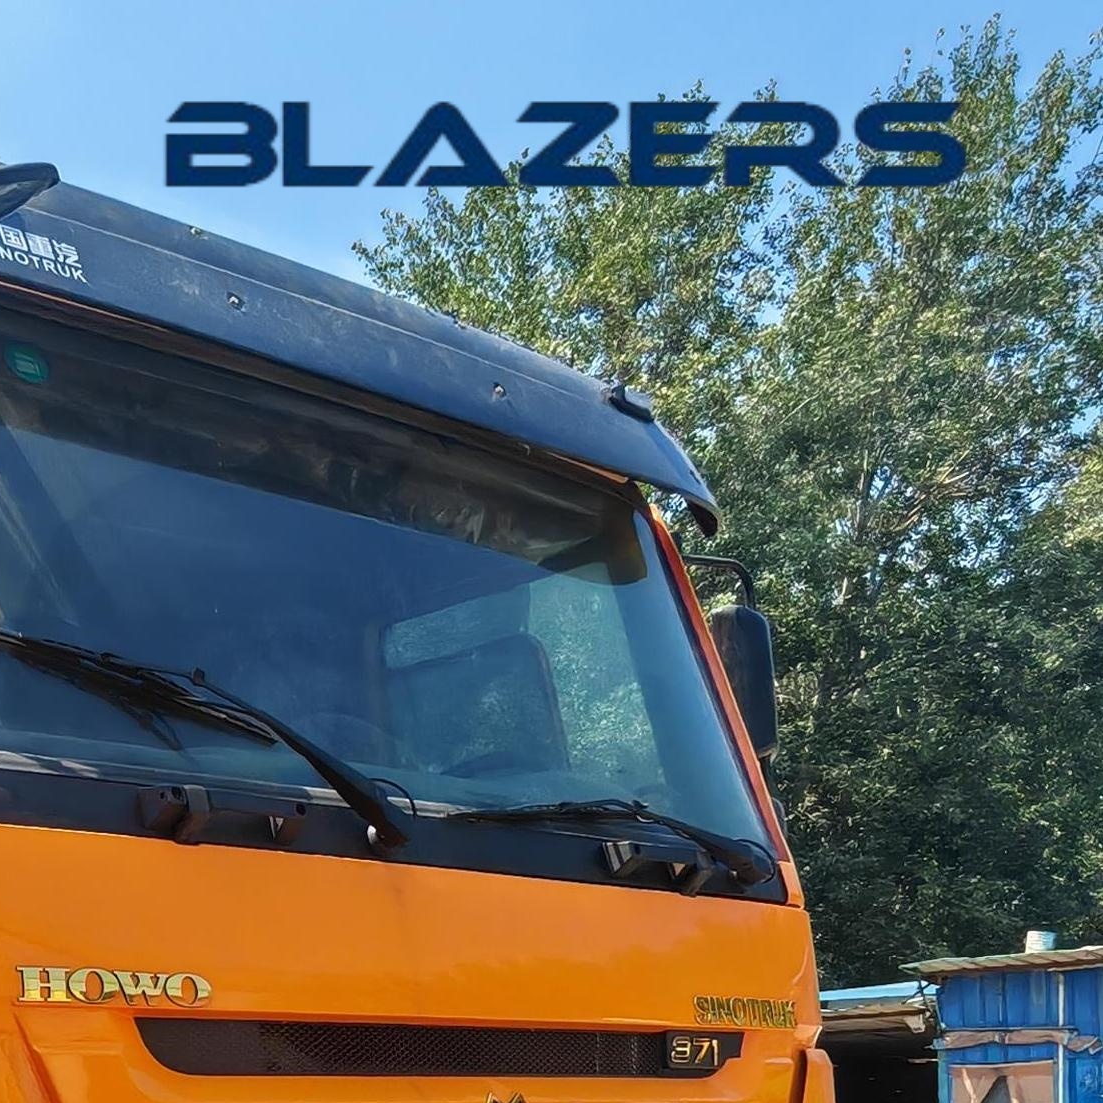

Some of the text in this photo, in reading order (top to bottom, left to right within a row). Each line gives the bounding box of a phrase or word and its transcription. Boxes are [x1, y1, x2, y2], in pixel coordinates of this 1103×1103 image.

[16, 966, 213, 1008] HOWO
[693, 995, 798, 1028] SINOTRUK
[671, 1035, 720, 1067] 371
